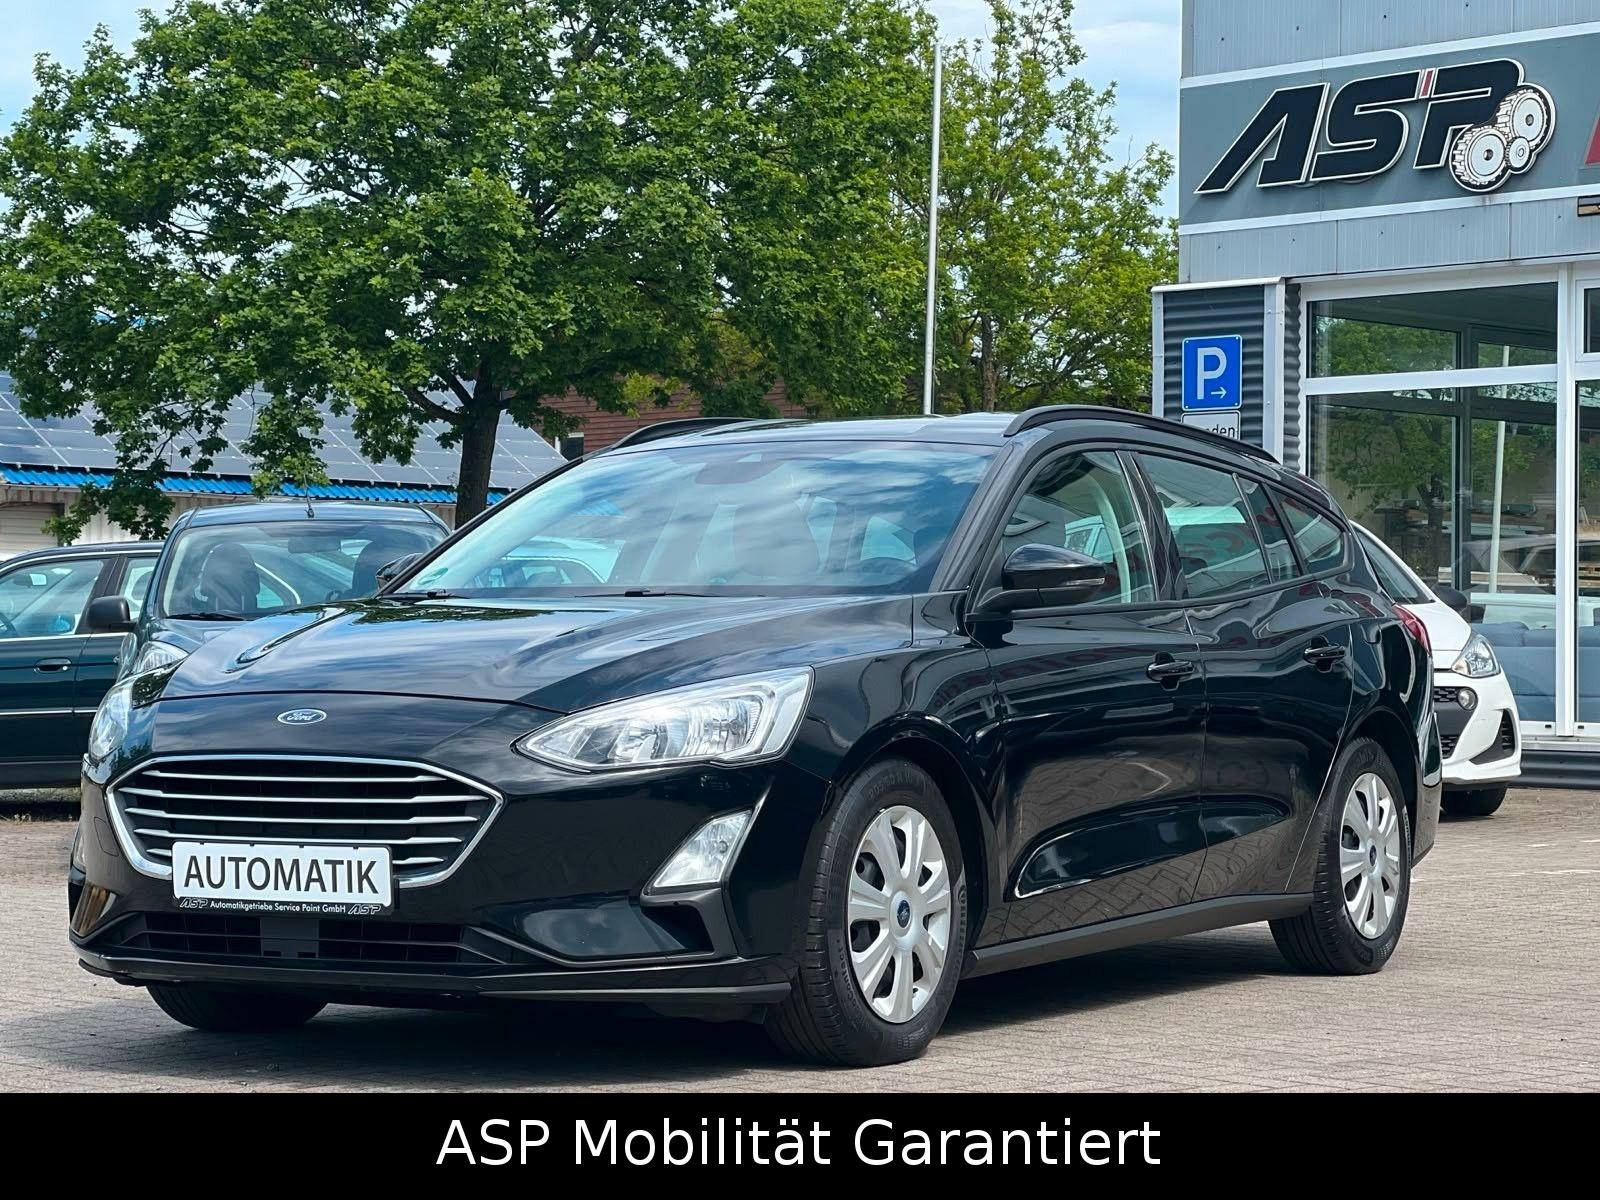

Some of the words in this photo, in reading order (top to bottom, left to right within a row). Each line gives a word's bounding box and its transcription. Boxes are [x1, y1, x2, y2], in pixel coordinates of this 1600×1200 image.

[1194, 58, 1525, 194] ASP
[1197, 347, 1227, 400] P
[184, 855, 379, 894] AUTOMATIK
[180, 898, 209, 909] ASP
[210, 900, 273, 912] Automatikgetriebe
[275, 902, 300, 912] Service
[322, 904, 346, 914] GmbH
[348, 904, 381, 915] ASP
